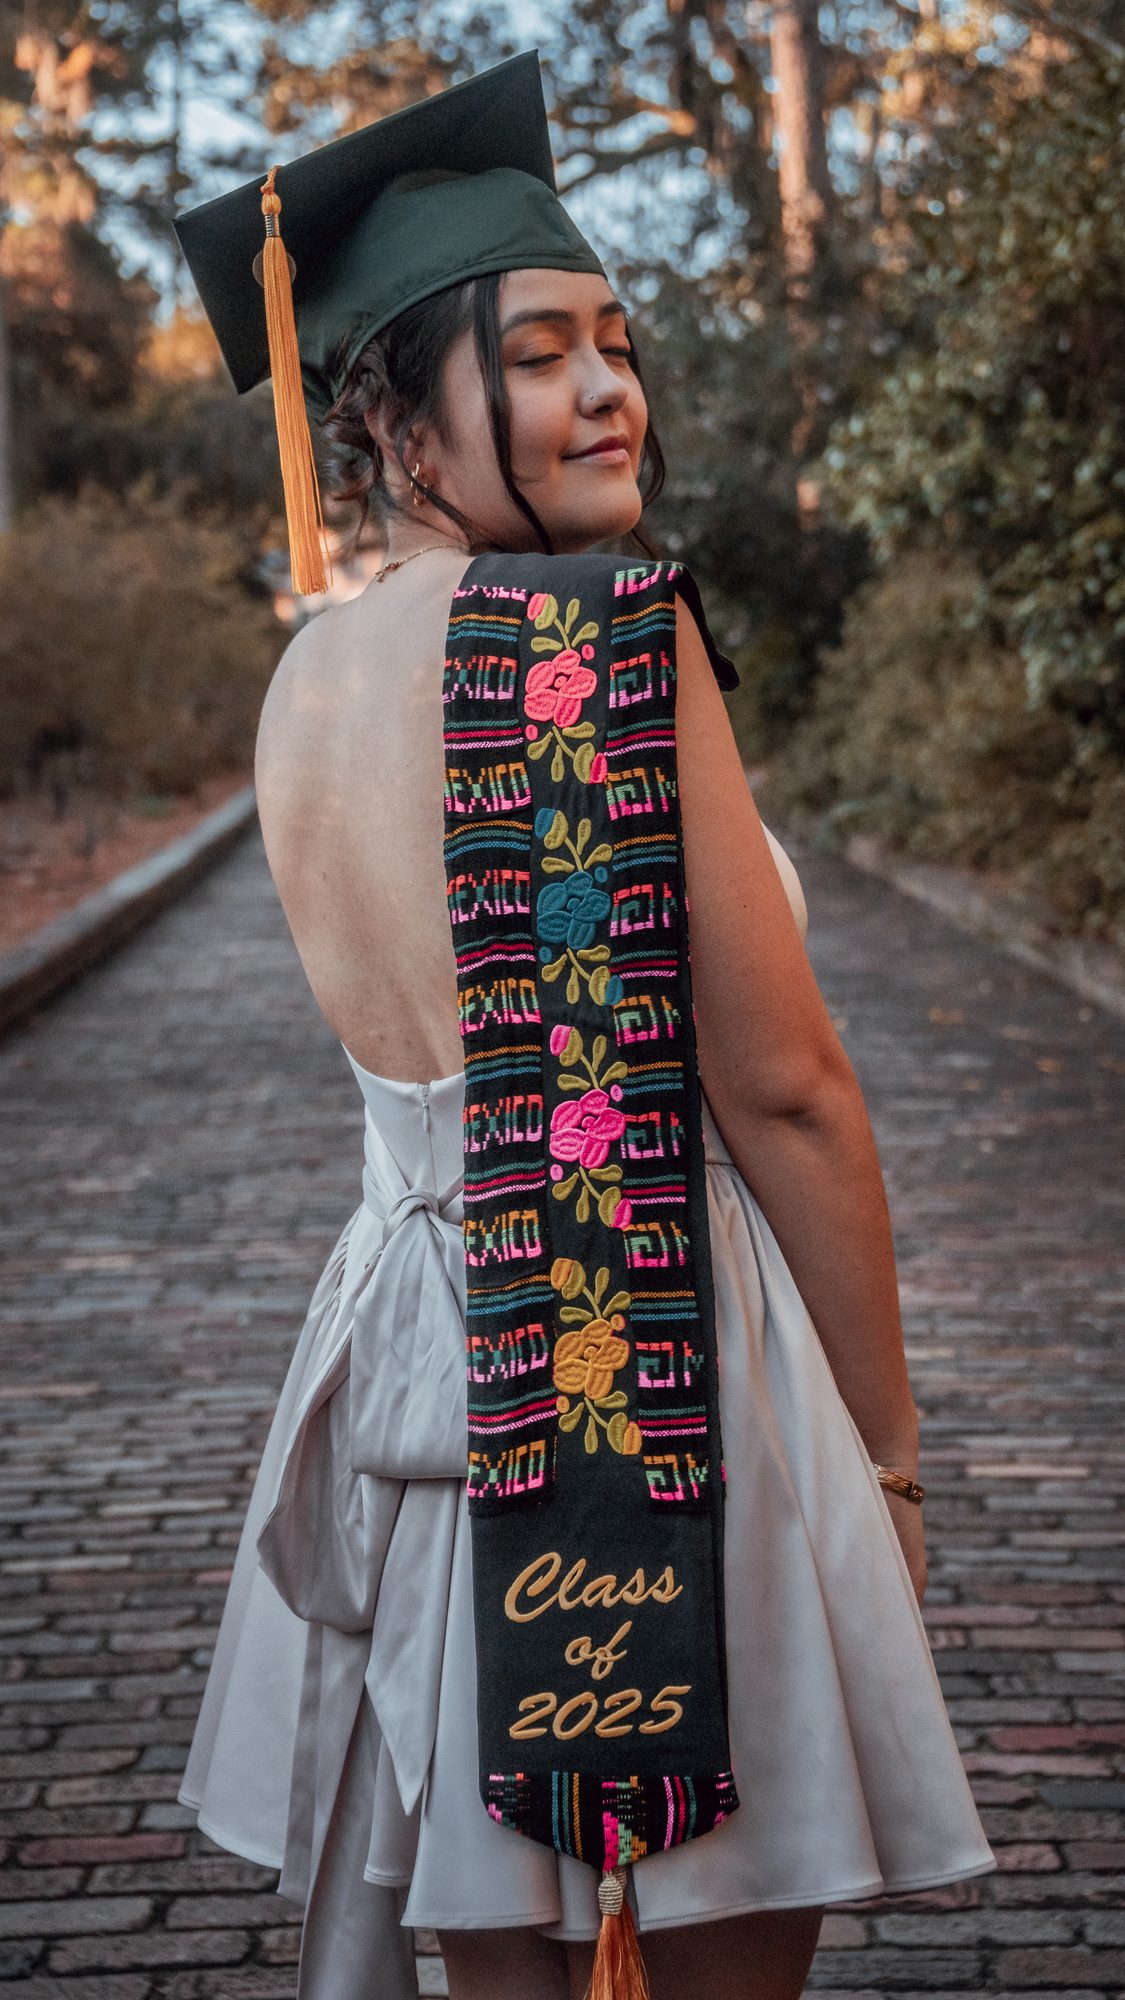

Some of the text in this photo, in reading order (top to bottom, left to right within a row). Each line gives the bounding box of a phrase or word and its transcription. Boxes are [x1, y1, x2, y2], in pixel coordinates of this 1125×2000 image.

[463, 1209, 542, 1267] EXICO
[504, 1552, 683, 1623] Class
[564, 1620, 633, 1680] of
[509, 1685, 692, 1740] 2025
